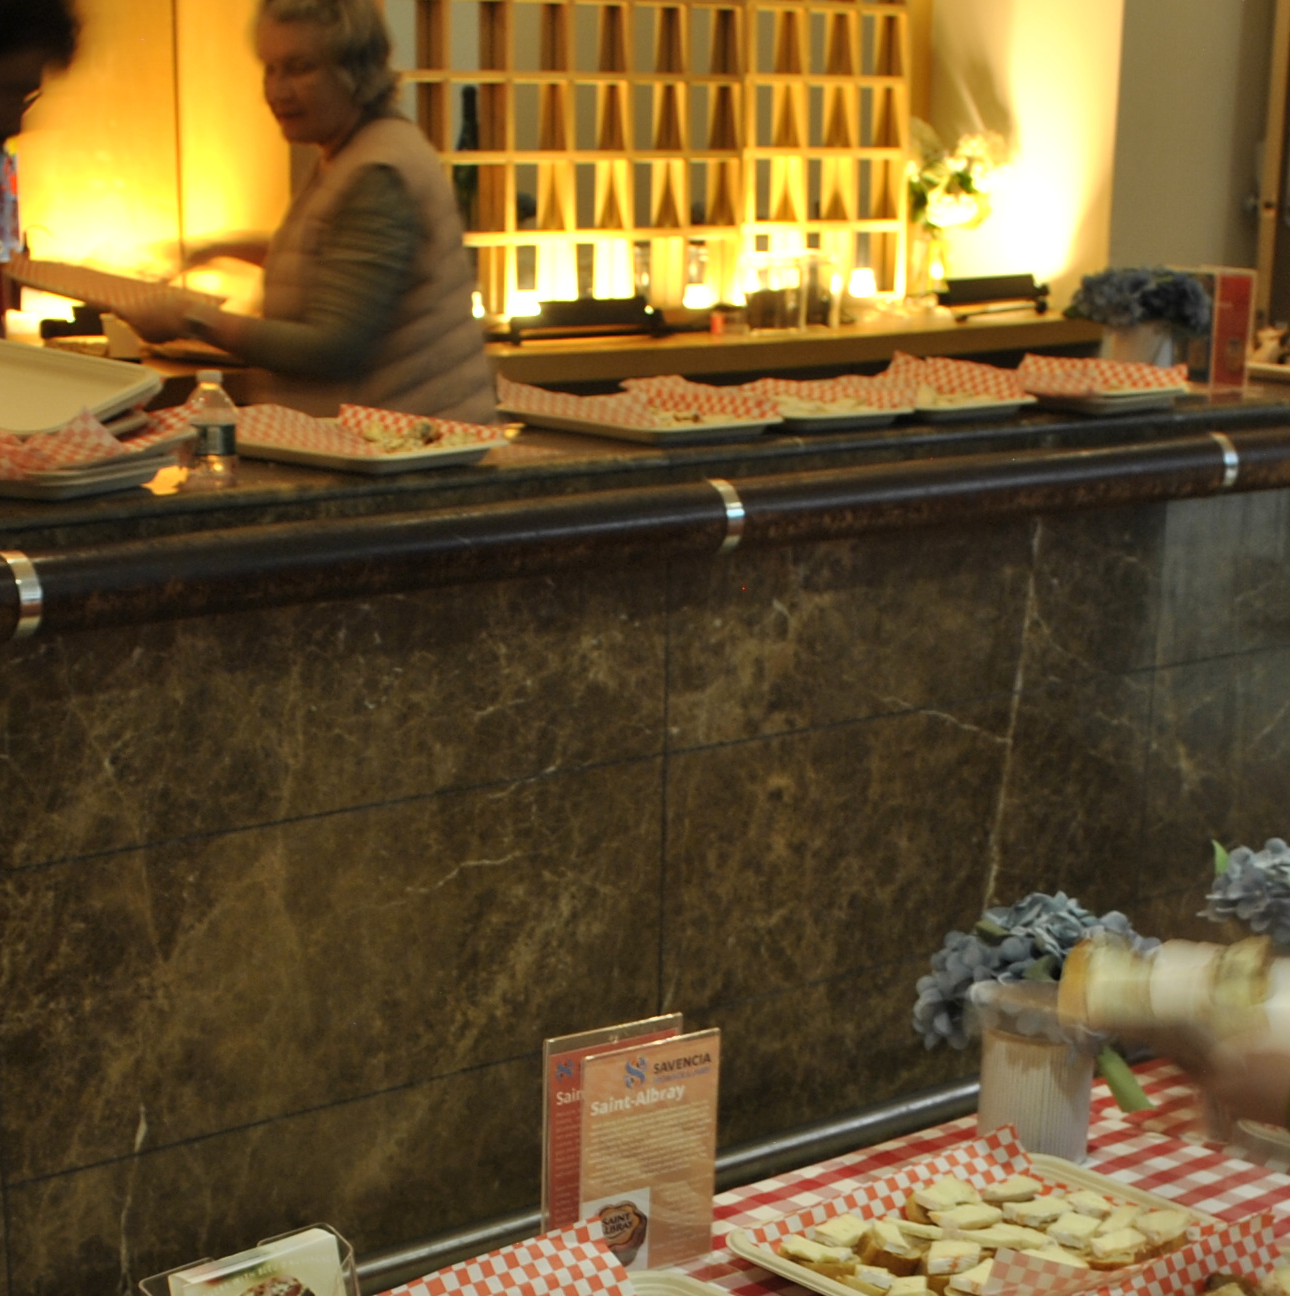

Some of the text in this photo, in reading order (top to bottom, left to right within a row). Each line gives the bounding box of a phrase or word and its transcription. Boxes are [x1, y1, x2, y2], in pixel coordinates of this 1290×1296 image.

[653, 1053, 711, 1074] SAVENCIA
[590, 1085, 685, 1116] Saint-Albray
[604, 1221, 632, 1234] LBRAY
